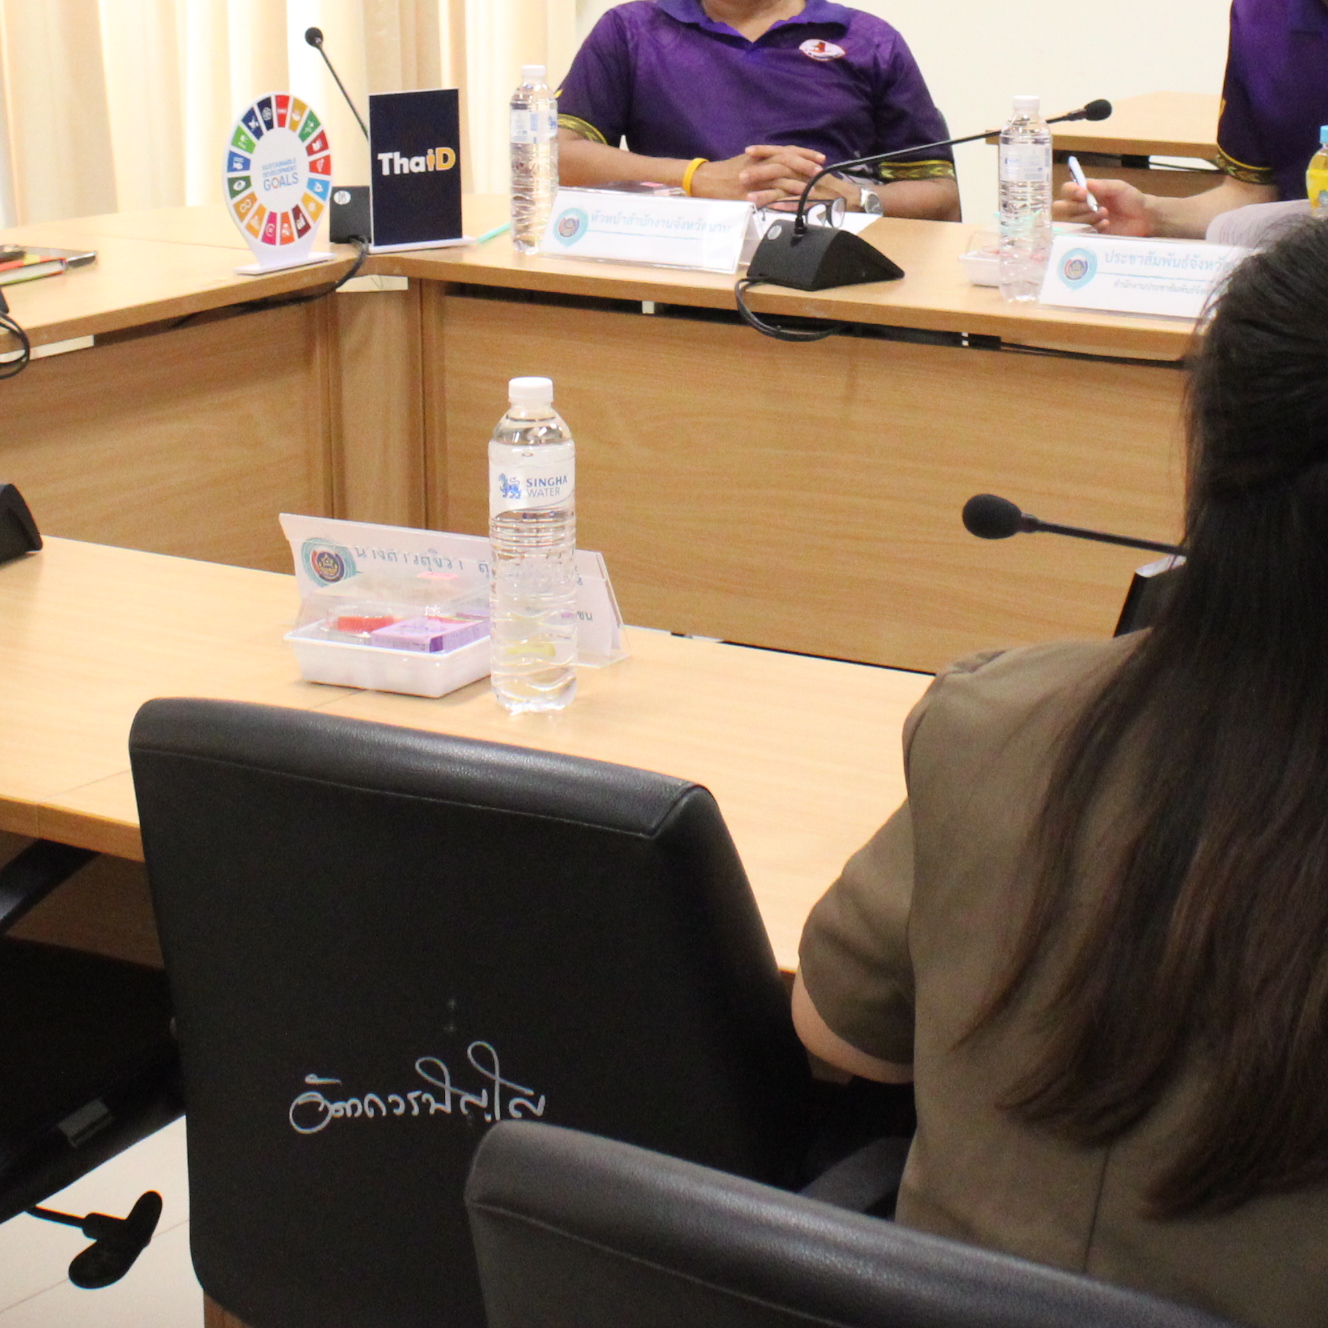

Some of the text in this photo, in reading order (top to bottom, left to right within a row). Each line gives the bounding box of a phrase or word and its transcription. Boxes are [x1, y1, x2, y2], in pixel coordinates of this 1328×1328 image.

[377, 147, 456, 176] ThaiD
[263, 172, 299, 191] GOALS
[526, 475, 568, 488] SINGHA
[526, 486, 561, 498] WATER
